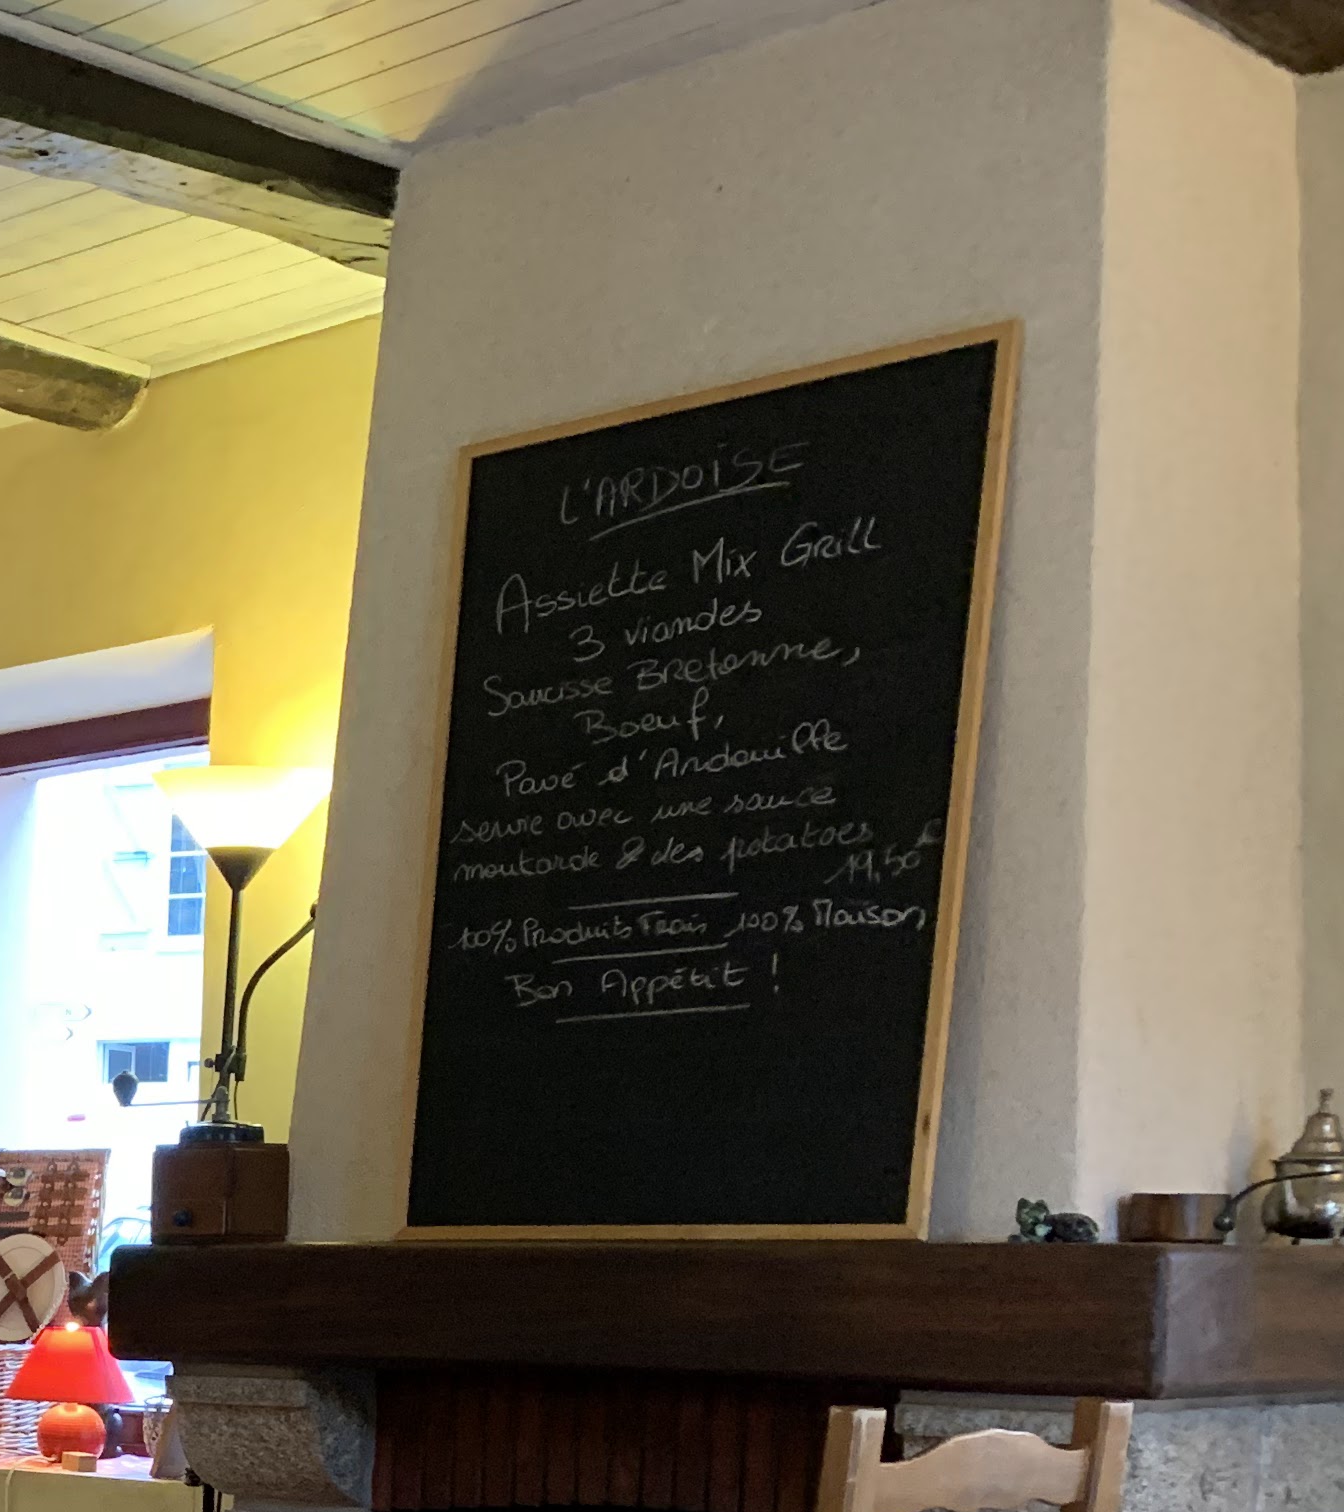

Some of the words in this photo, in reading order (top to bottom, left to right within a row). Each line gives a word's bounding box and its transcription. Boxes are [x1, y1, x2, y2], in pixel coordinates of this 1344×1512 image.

[495, 559, 668, 635] Assiette
[692, 536, 758, 584] Mix
[568, 624, 606, 663] 3
[483, 673, 613, 716] Saucisse
[573, 686, 723, 745] Boeuf,
[496, 759, 581, 798] Pavé
[557, 808, 634, 831] avec
[651, 796, 713, 824] une
[723, 786, 837, 814] sauce
[453, 845, 601, 882] moutarde
[650, 836, 704, 866] des
[720, 821, 874, 875] potatoes
[523, 915, 633, 948] Produits
[723, 904, 805, 938] 100%
[812, 898, 927, 931] Maison
[504, 973, 573, 1007] Bon
